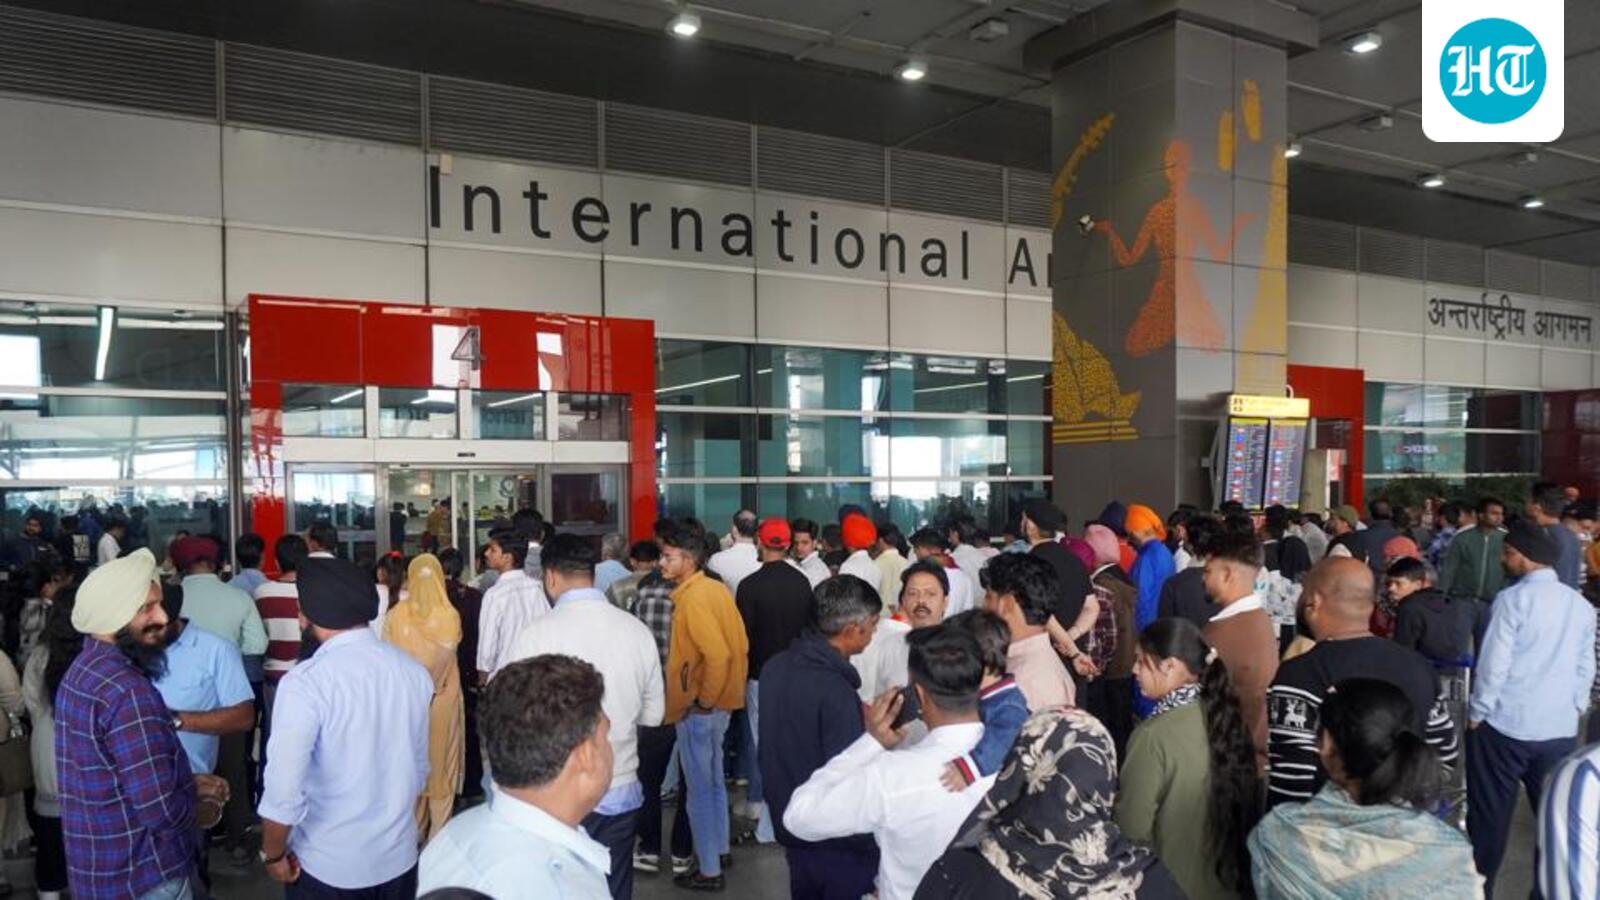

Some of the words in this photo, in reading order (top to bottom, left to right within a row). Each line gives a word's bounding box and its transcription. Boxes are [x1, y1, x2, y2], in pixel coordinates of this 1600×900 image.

[429, 165, 969, 281] International
[1428, 292, 1526, 340] अन्तर्राष्ट्रीय
[1533, 310, 1593, 343] आगमन
[451, 327, 487, 371] 4
